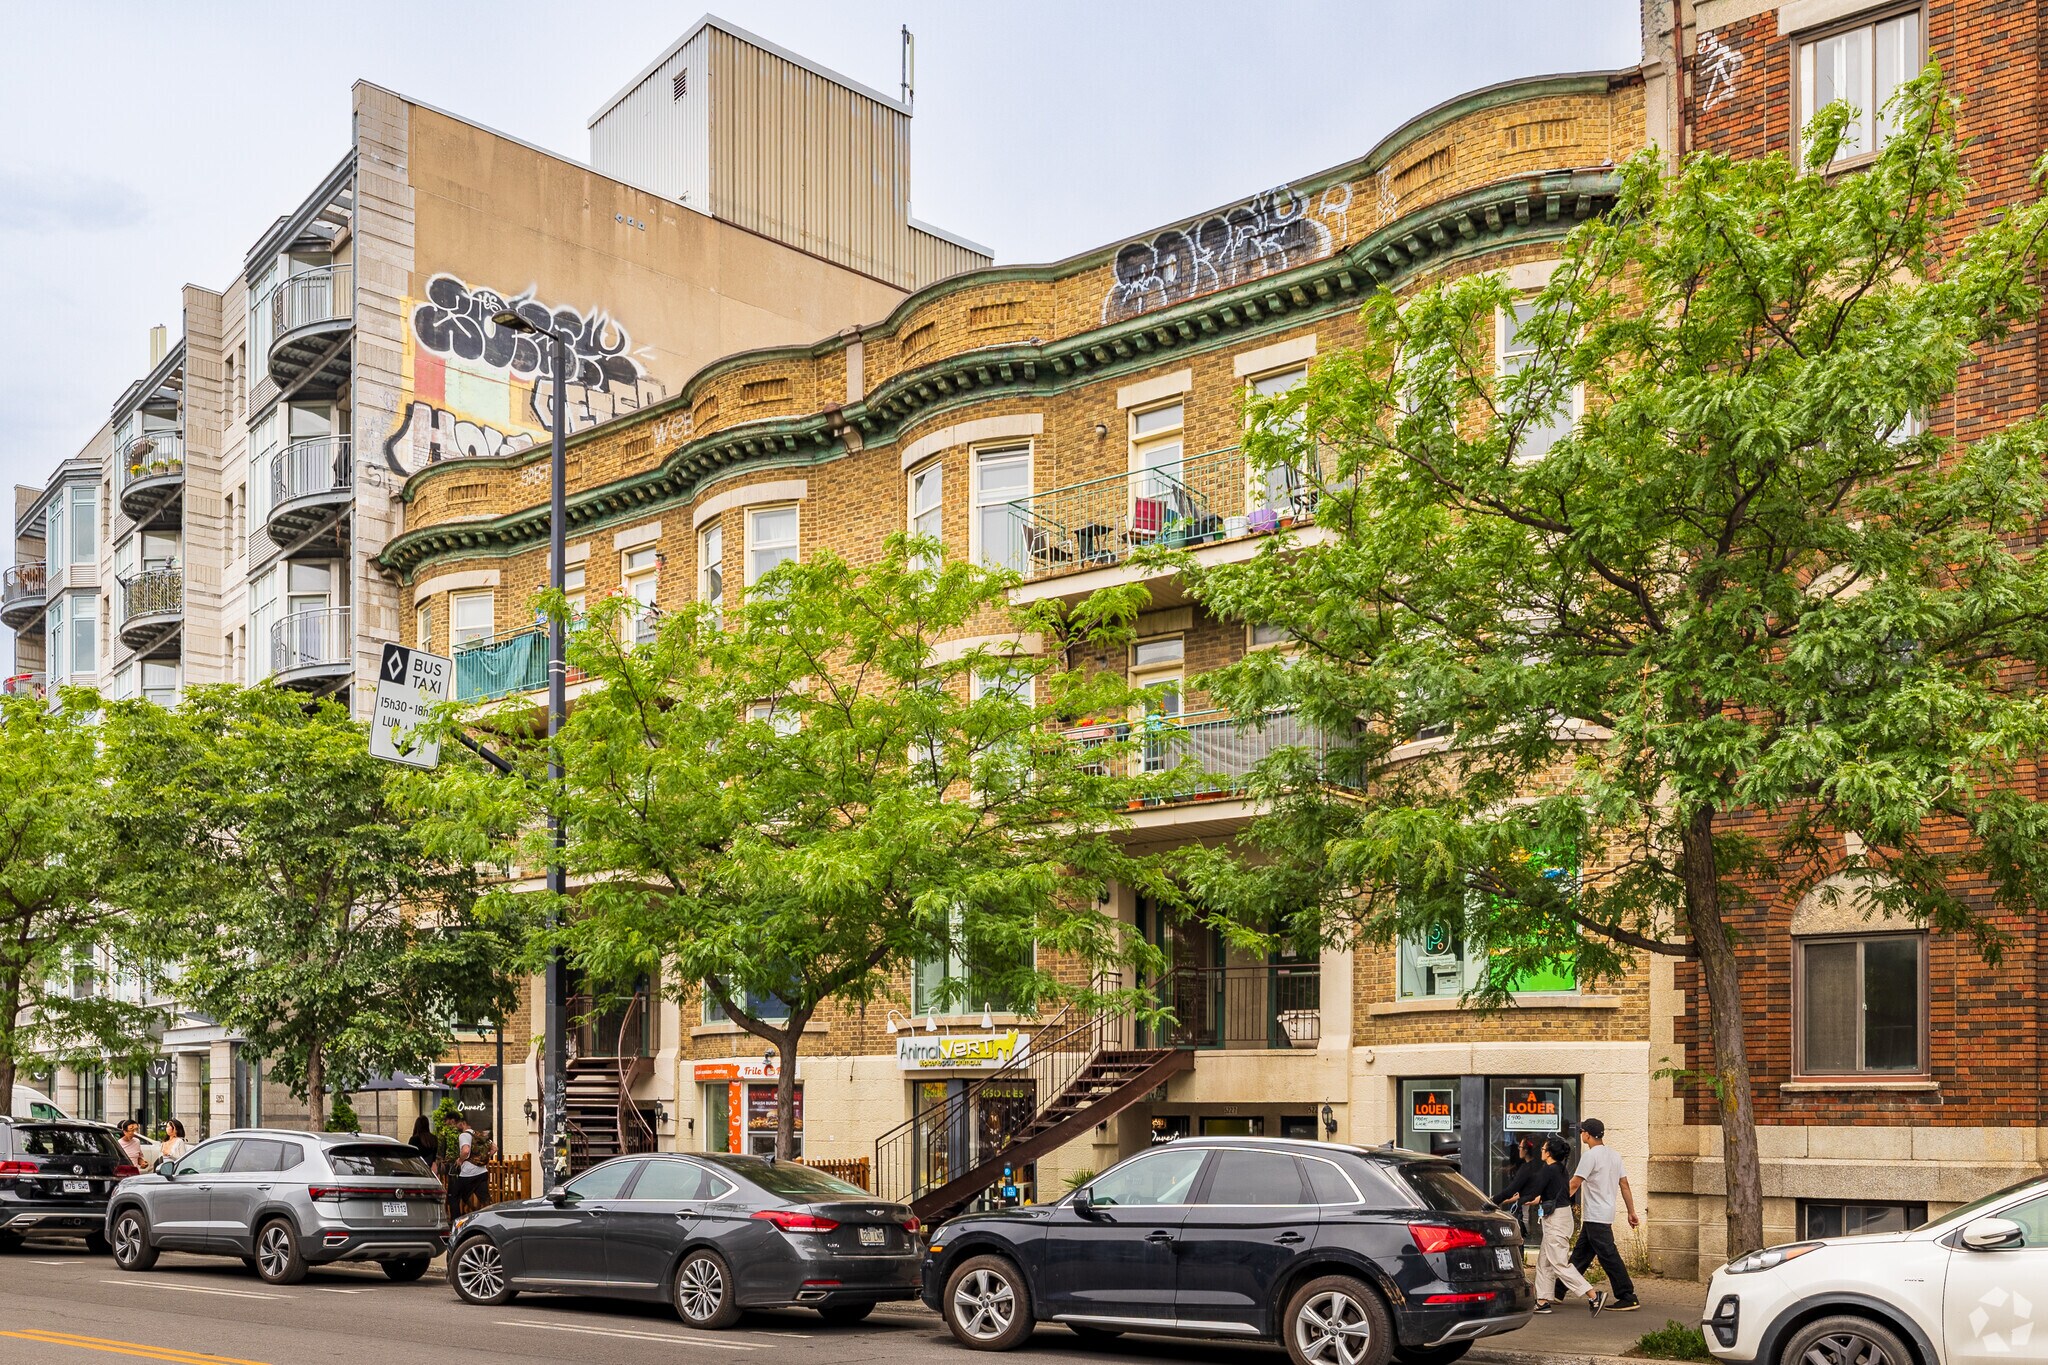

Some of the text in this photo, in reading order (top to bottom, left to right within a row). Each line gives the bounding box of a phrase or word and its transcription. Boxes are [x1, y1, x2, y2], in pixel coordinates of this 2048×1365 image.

[413, 658, 442, 677] BUS
[412, 675, 442, 694] TAXI
[380, 696, 407, 712] 15h30
[1415, 1104, 1449, 1115] LOUER
[1509, 1102, 1556, 1114] LOUER
